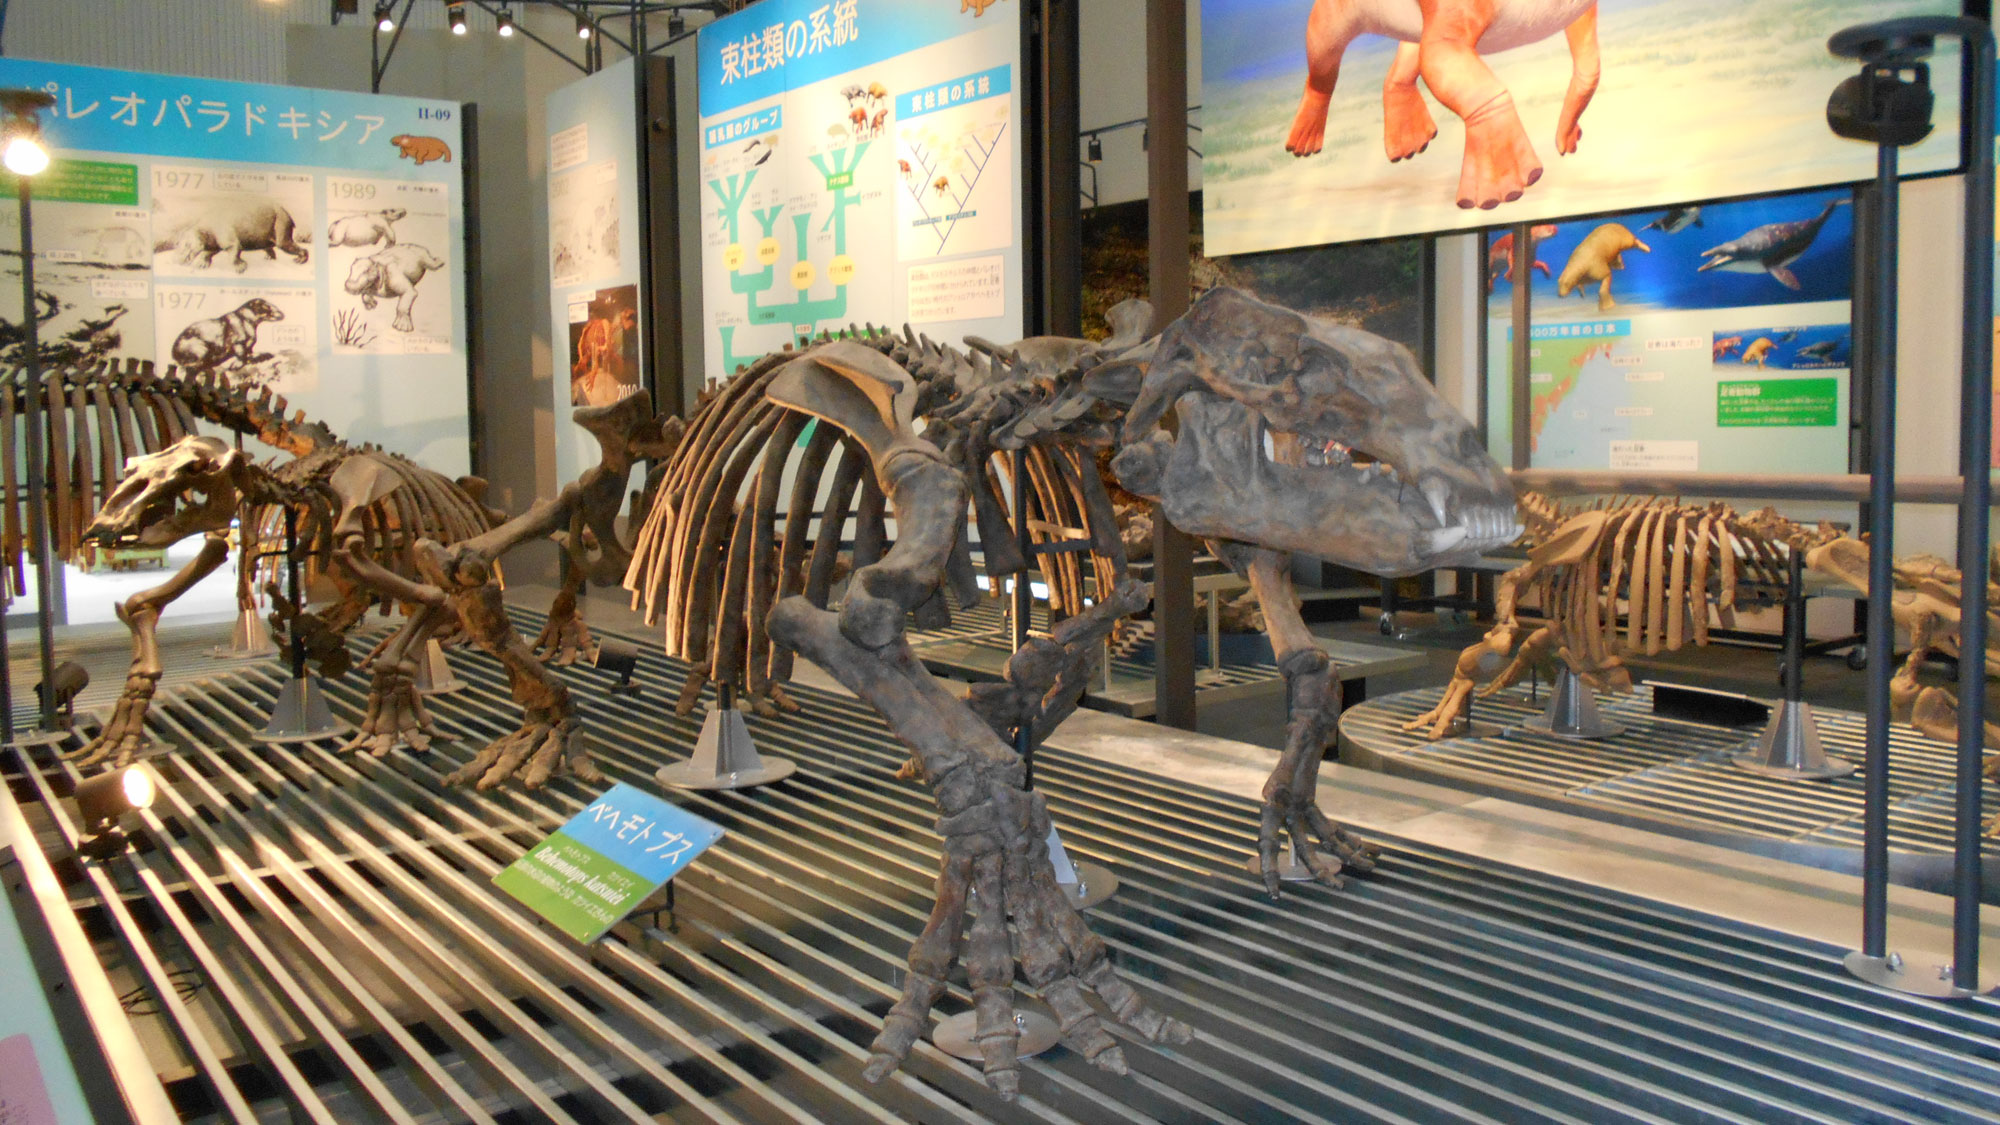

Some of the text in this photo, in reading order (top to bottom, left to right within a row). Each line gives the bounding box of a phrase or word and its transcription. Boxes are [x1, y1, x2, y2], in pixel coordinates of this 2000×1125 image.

[720, 0, 859, 86] 束柱類の系統
[417, 107, 451, 121] II-09
[154, 170, 204, 189] 1977
[330, 182, 377, 200] 1989
[156, 291, 207, 309] 1977
[1530, 323, 1617, 337] 00万年前の日本
[588, 802, 694, 865] ベヘモトプス
